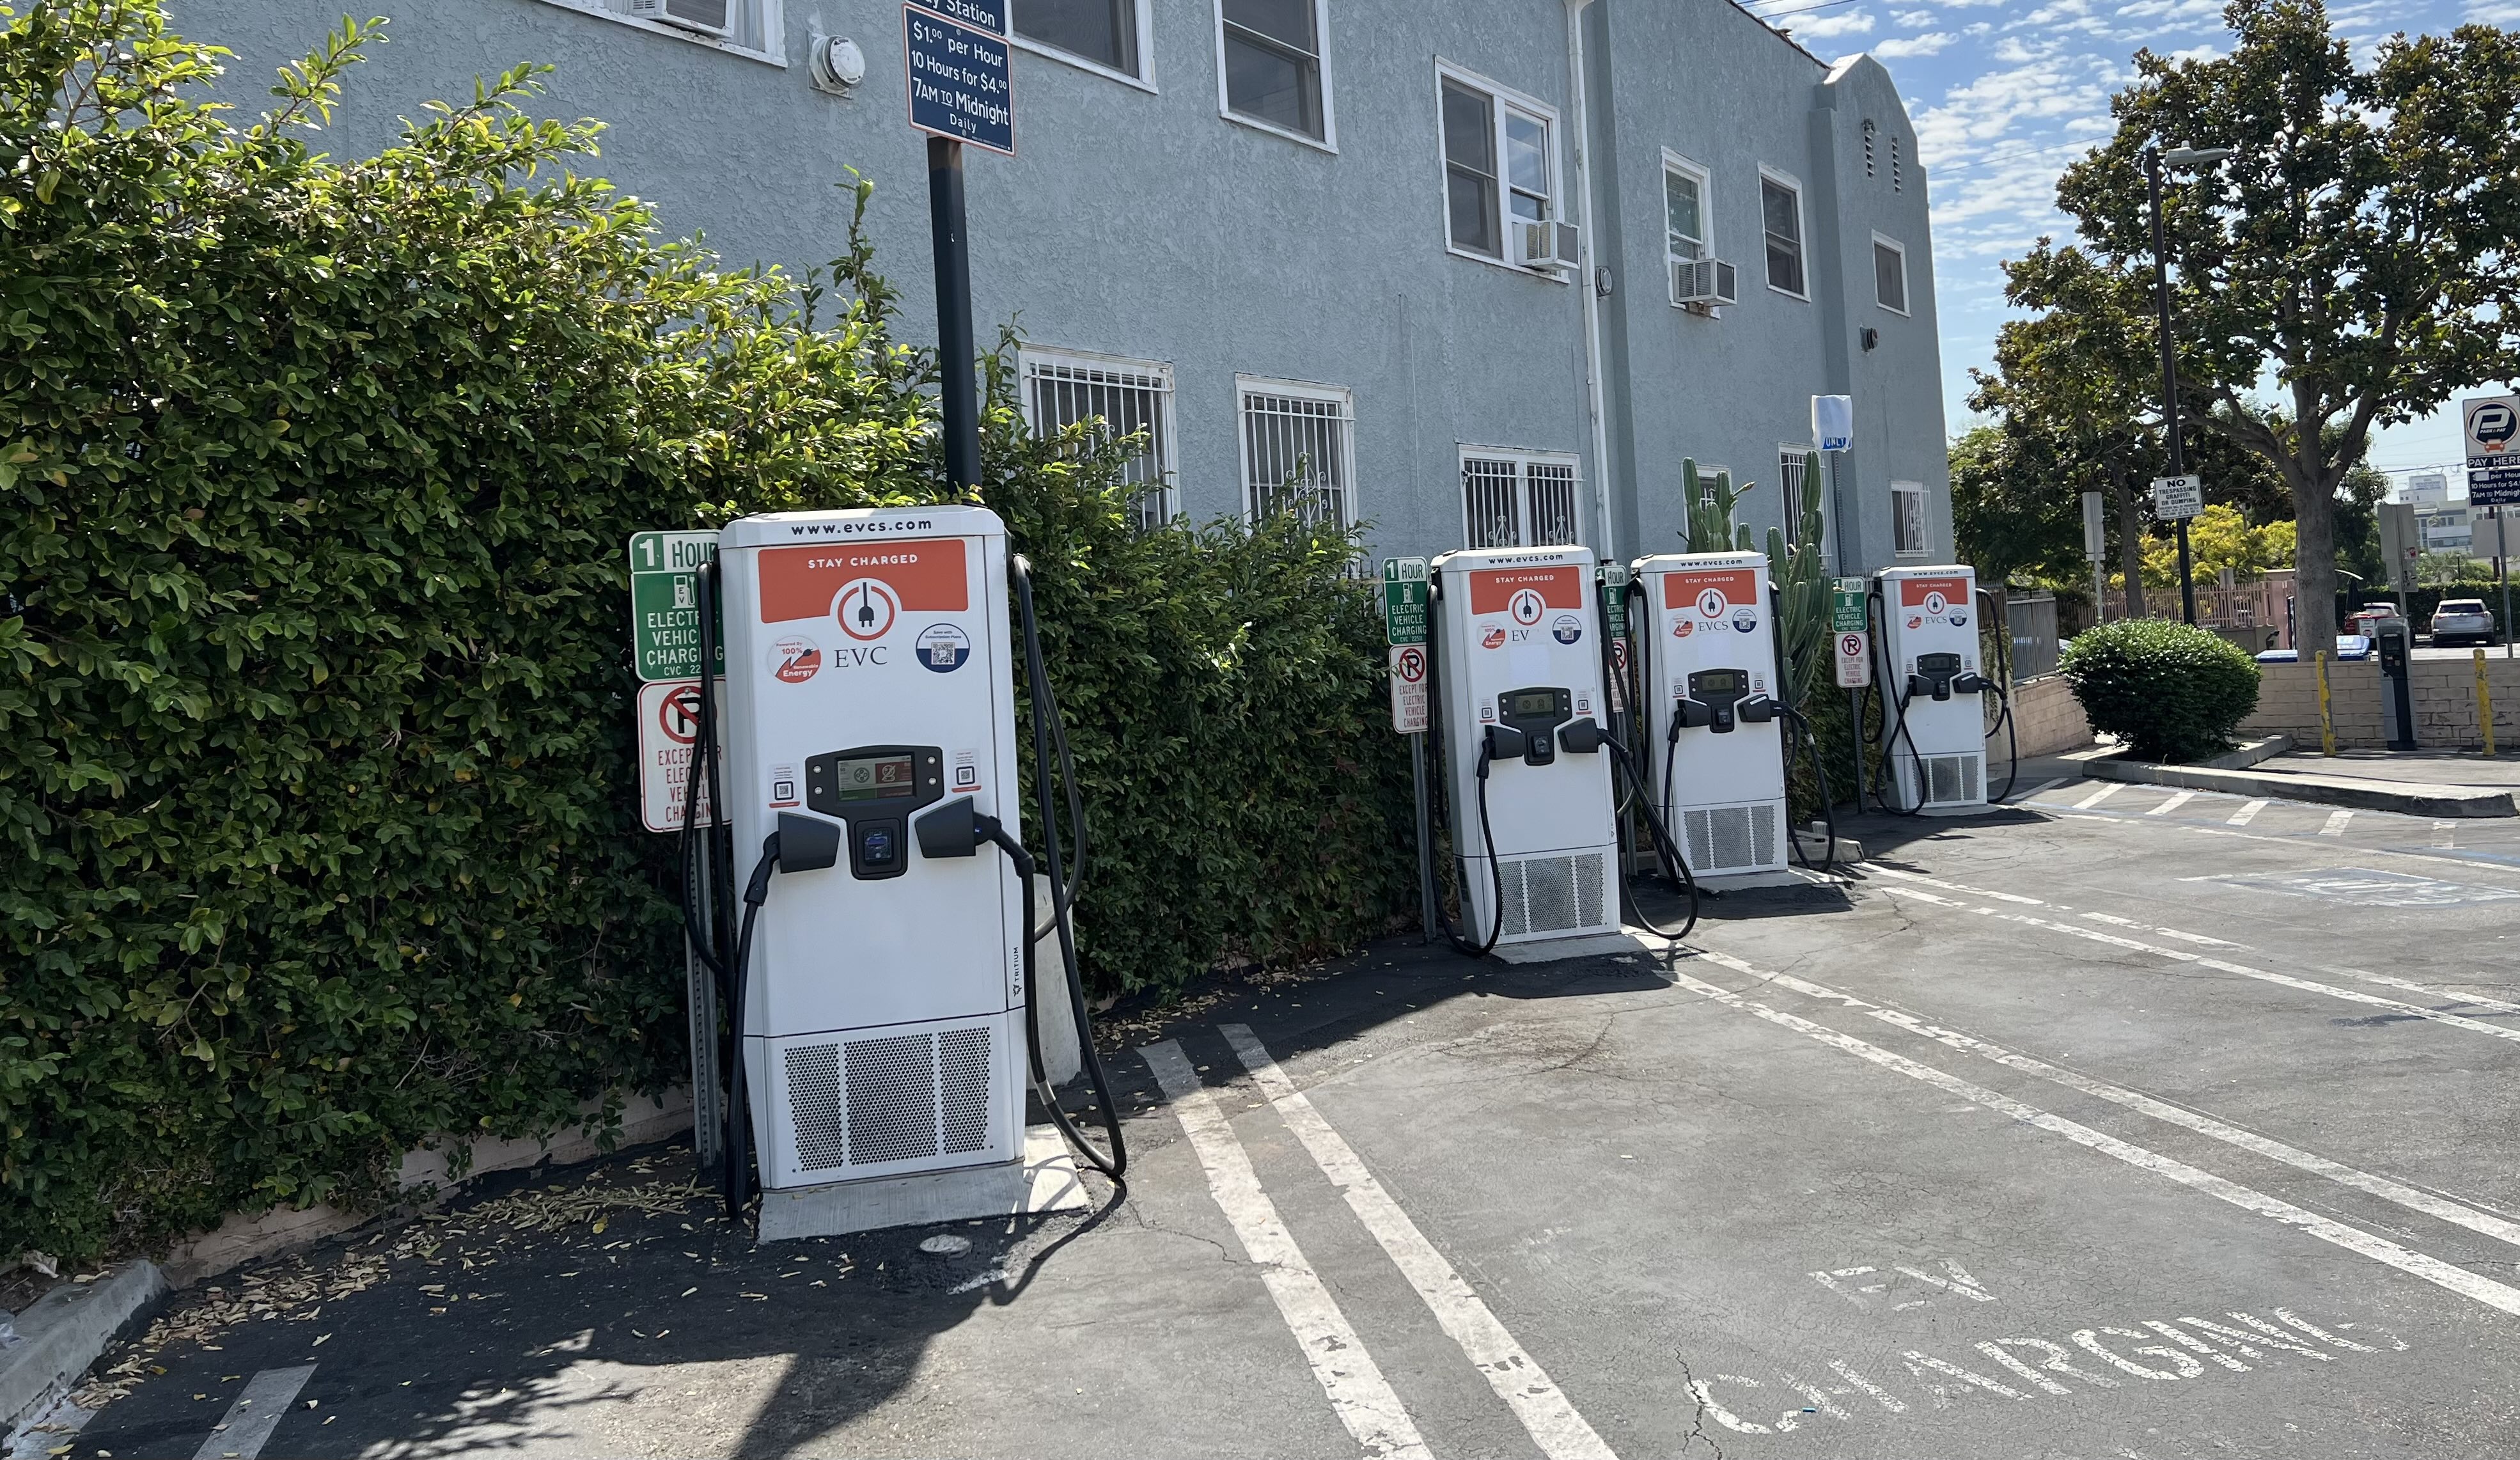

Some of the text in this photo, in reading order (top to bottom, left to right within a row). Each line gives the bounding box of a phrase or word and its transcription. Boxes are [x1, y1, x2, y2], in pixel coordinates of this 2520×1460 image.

[948, 38, 968, 55] per
[974, 43, 1003, 67] Hour
[911, 50, 924, 68] 10
[927, 55, 959, 81] Hours
[962, 68, 978, 86] for
[912, 77, 1009, 125] 7AM TO Midnight
[950, 113, 976, 134] Daily
[2468, 457, 2488, 467] PAY
[2159, 486, 2196, 495] TRESPASSING
[2494, 489, 2520, 498] Midnigh
[792, 520, 932, 535] www.evcs.com
[639, 538, 655, 567] 1
[808, 554, 918, 569] STAY CHARGED
[1489, 554, 1563, 564] www.evcs.com
[1387, 561, 1423, 579] 1 HOUR
[1608, 571, 1624, 585] HOUR
[1844, 581, 1861, 592] HOUR
[1391, 604, 1424, 614] ELECTRIC
[1607, 605, 1624, 614] ECTRIC
[1394, 615, 1423, 625] VEHICLE
[1698, 620, 1728, 631] EVCS
[1391, 625, 1427, 636] CHARGING
[1512, 629, 1530, 641] EV
[652, 629, 701, 647] VEHIC
[646, 646, 723, 666] CHARGIG
[834, 646, 888, 668] EVC
[664, 666, 682, 676] CVC
[1399, 684, 1418, 695] EXCEPT
[1403, 695, 1425, 705] ELECTRIC
[1405, 705, 1425, 716] VEHICLE
[1404, 716, 1428, 728] CHARGING
[658, 747, 694, 765] EXCEP
